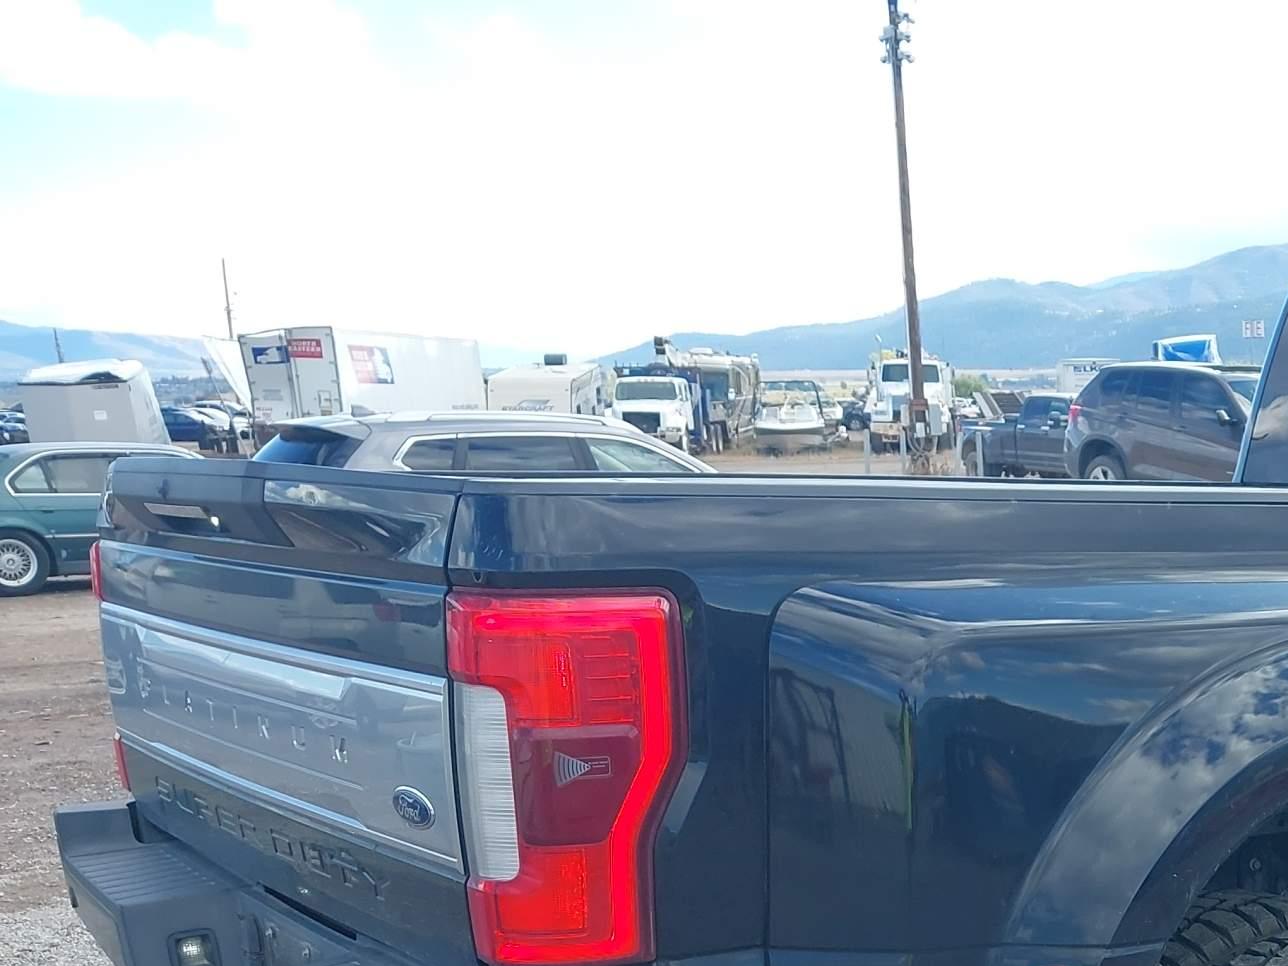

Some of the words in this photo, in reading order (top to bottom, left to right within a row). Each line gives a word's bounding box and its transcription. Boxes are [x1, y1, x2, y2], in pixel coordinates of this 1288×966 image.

[138, 676, 349, 765] PLATINUM
[154, 775, 265, 849] SUPER
[269, 828, 392, 901] DUTY
